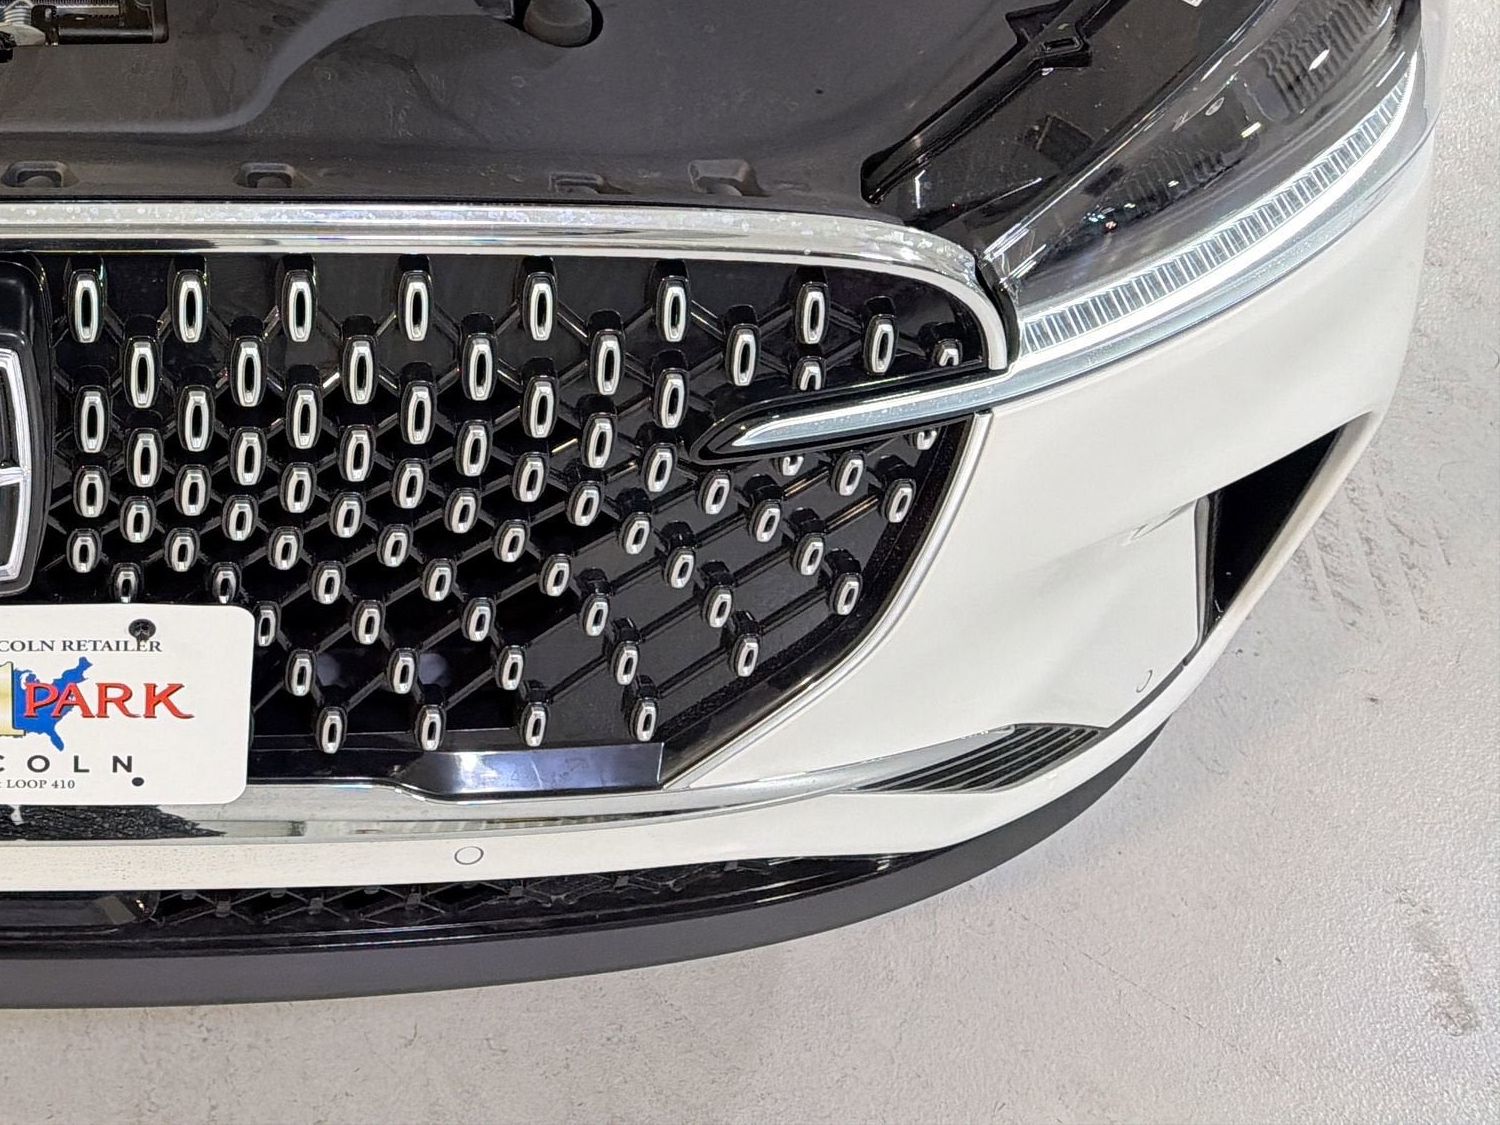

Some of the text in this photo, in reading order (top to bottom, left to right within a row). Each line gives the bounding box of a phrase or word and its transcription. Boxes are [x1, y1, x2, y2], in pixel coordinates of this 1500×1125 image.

[61, 639, 163, 653] RETAILER
[23, 681, 196, 719] PARK
[6, 778, 48, 790] LOOP
[51, 779, 76, 790] 410
